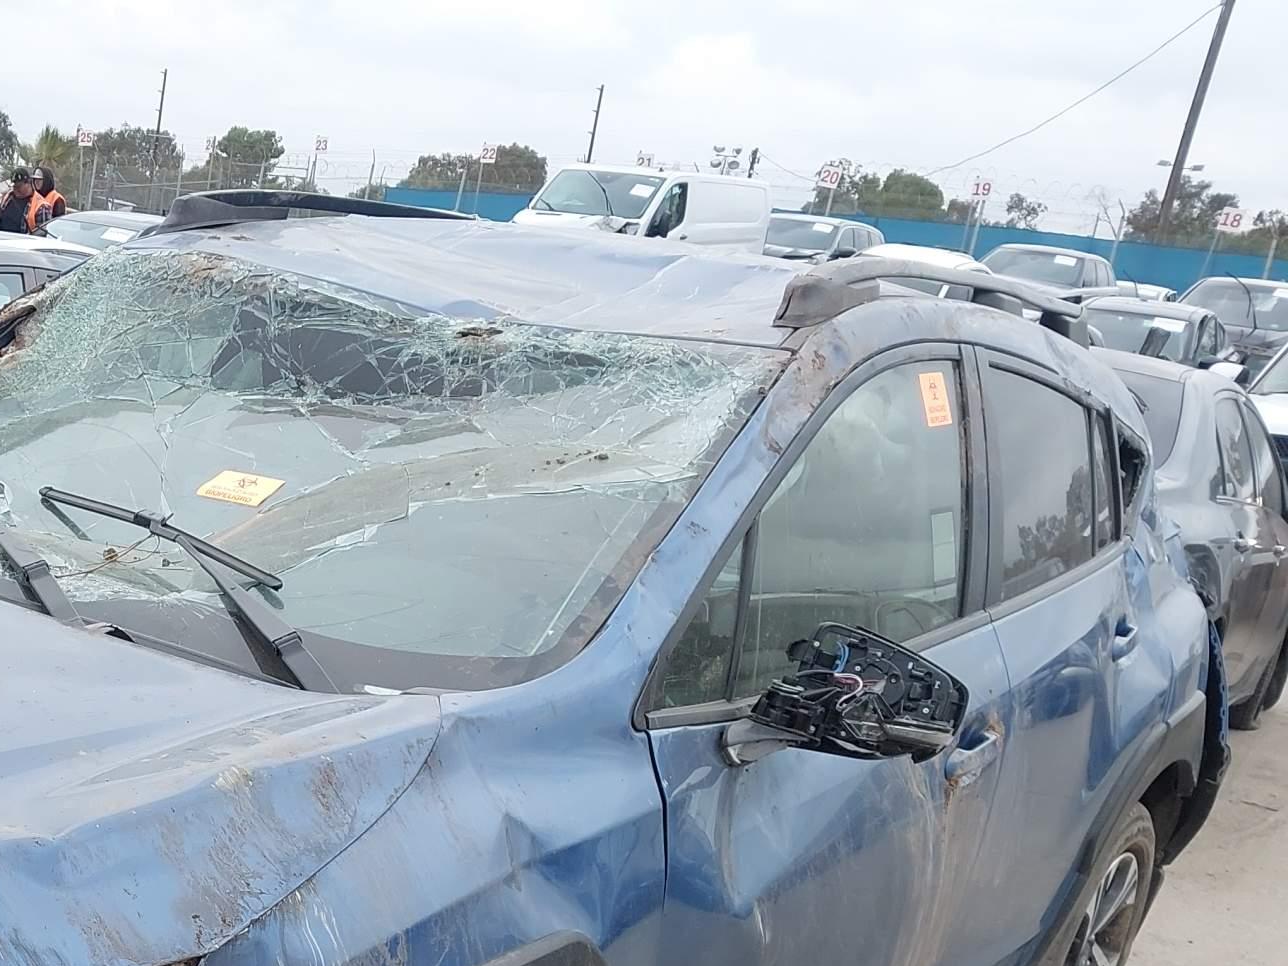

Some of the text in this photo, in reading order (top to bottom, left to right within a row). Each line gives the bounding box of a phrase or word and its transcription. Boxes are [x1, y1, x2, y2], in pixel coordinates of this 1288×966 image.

[80, 133, 92, 143] 25
[315, 139, 328, 151] 23
[482, 148, 496, 159] 22
[637, 157, 652, 167] 21
[820, 169, 840, 185] 20
[972, 182, 991, 196] 19
[1219, 212, 1242, 228] 18
